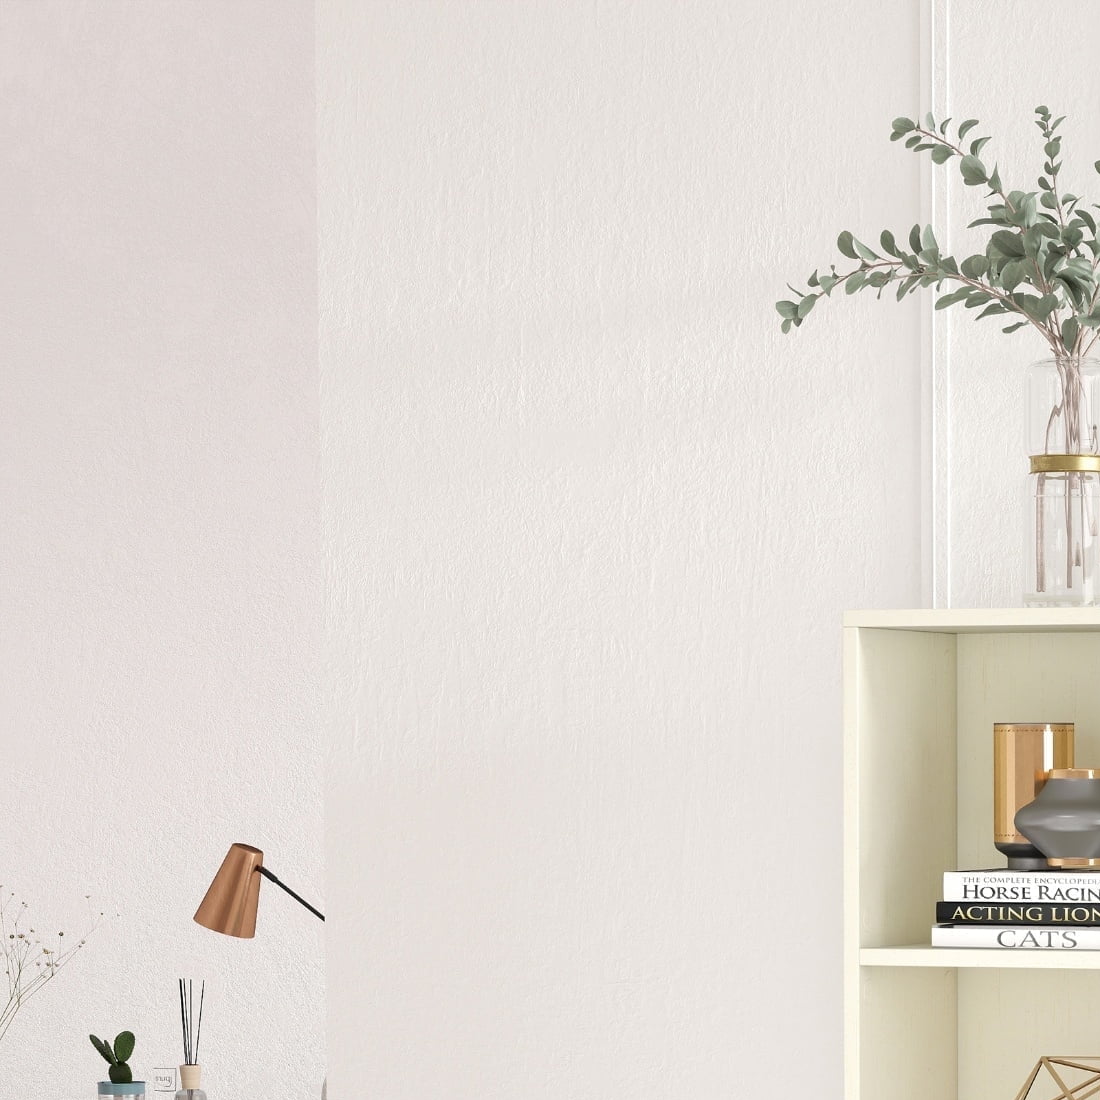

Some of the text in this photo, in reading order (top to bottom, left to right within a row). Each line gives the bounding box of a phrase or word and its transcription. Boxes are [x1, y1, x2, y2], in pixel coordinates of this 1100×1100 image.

[962, 876, 982, 884] THE
[983, 876, 1032, 885] COMPLETE
[962, 884, 1032, 900] HORSE
[951, 905, 1043, 921] ACTING
[996, 930, 1078, 949] CATS
